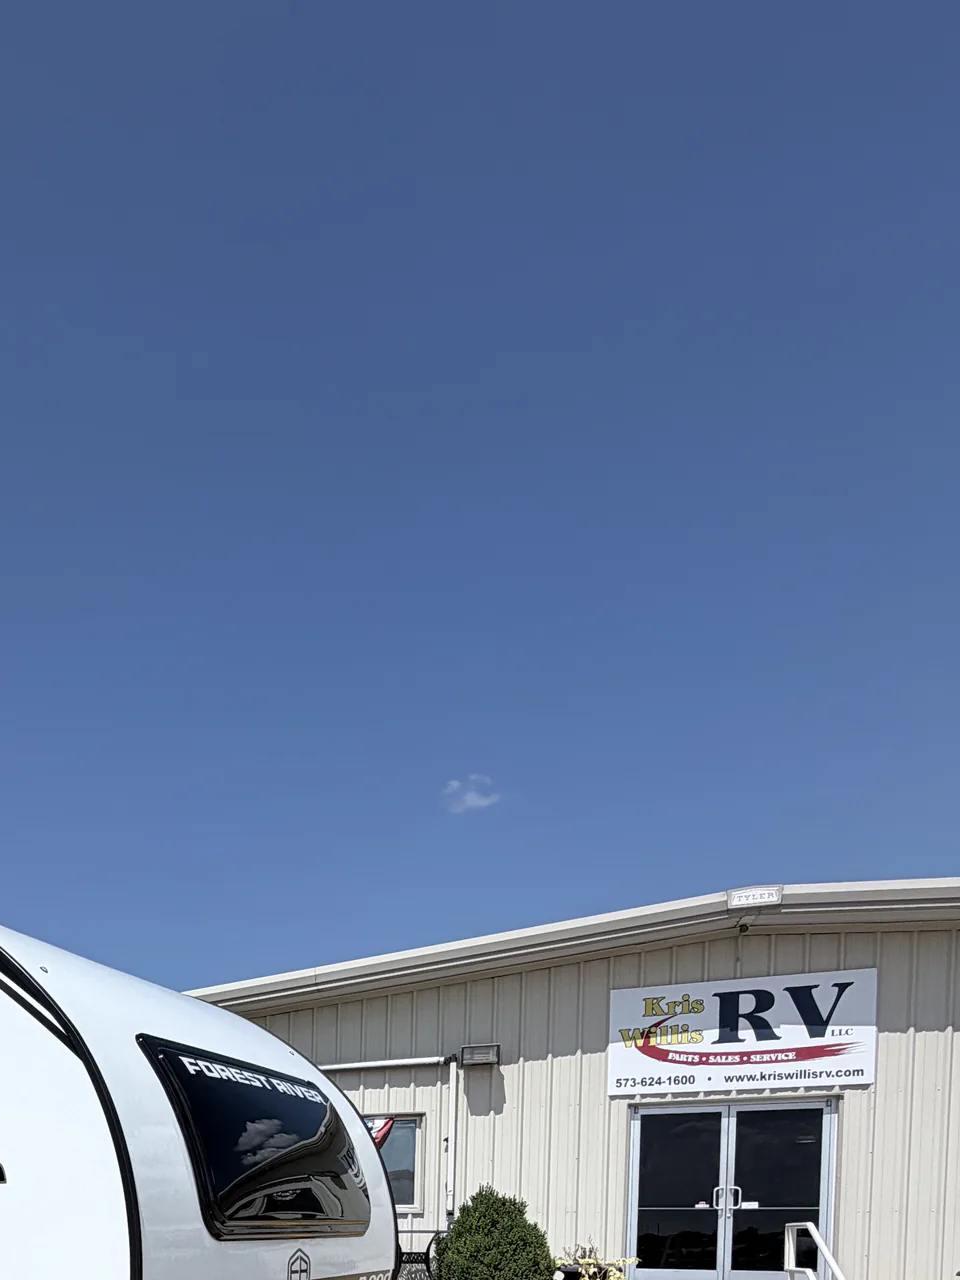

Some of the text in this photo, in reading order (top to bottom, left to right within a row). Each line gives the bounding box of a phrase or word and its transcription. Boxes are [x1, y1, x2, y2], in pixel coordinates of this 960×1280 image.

[736, 892, 775, 902] TYLER
[642, 994, 705, 1017] Kris
[711, 981, 855, 1045] RV LLC
[619, 1024, 704, 1048] Willis
[667, 1052, 797, 1063] PARTS SALES SERVICE
[178, 1055, 328, 1106] FOREST RIVER
[615, 1068, 865, 1088] 573-624-1600 www.kriswillisrv.com
